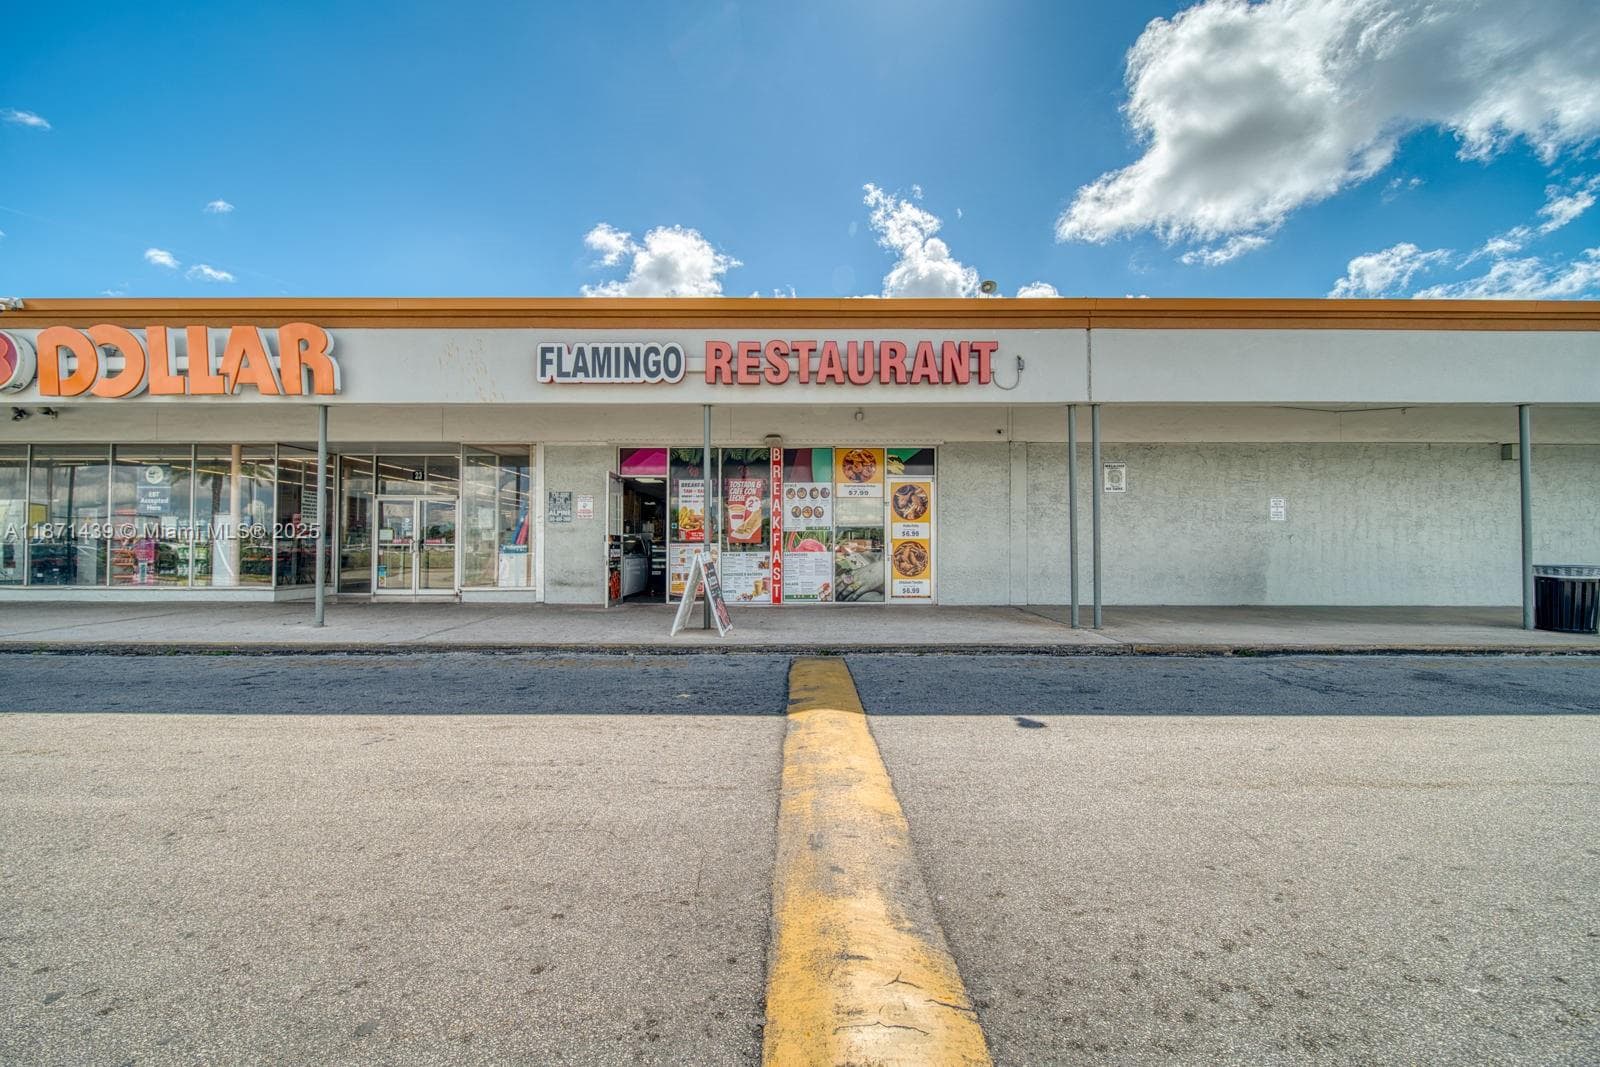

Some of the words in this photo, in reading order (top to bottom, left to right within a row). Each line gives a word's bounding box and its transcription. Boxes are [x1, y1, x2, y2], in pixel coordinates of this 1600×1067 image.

[37, 322, 336, 397] DOLLAR
[539, 346, 682, 379] FLAMINGO
[704, 340, 998, 386] RESTAURANT
[772, 448, 781, 598] BREAKFAST
